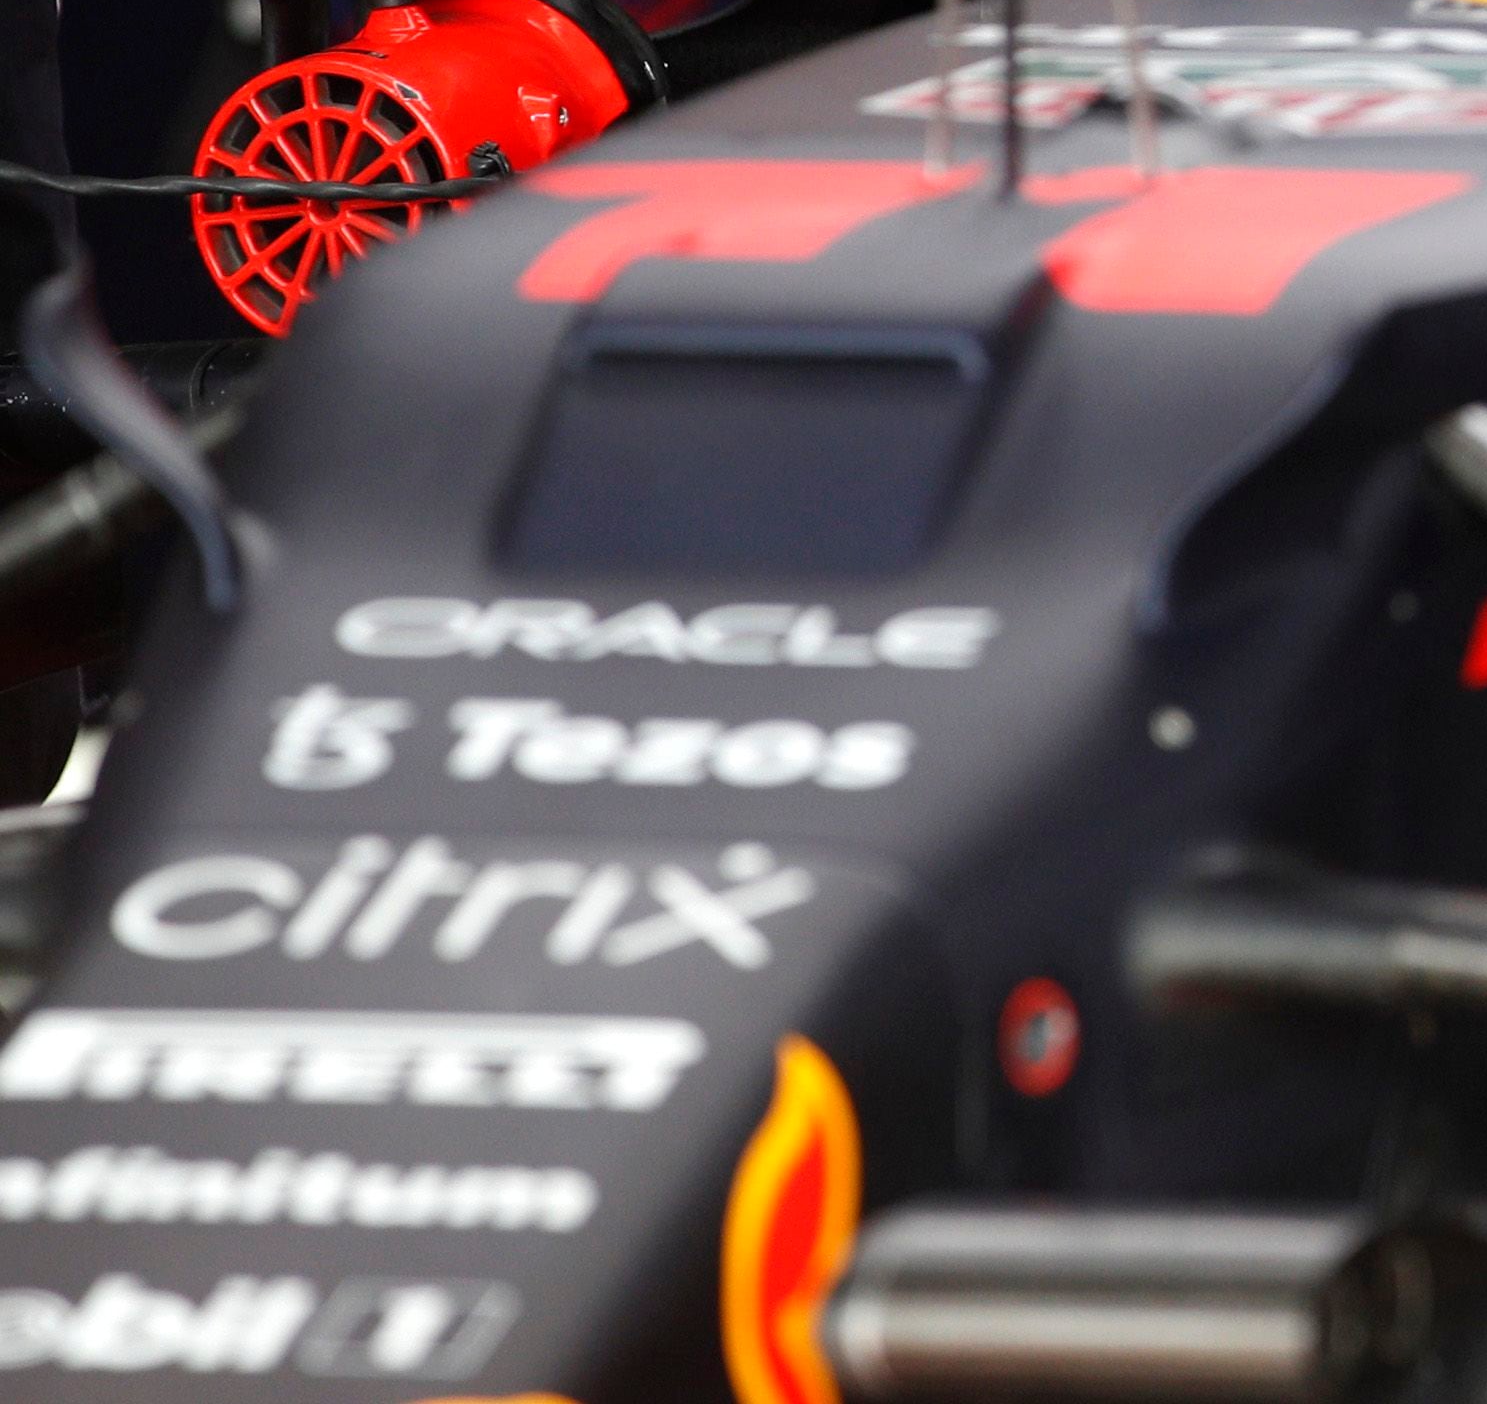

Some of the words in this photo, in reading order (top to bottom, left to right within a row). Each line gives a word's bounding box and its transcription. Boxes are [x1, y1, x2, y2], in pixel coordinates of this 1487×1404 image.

[334, 597, 1000, 669] ORACLE
[445, 697, 915, 789] Tezos
[111, 836, 813, 971] citrix
